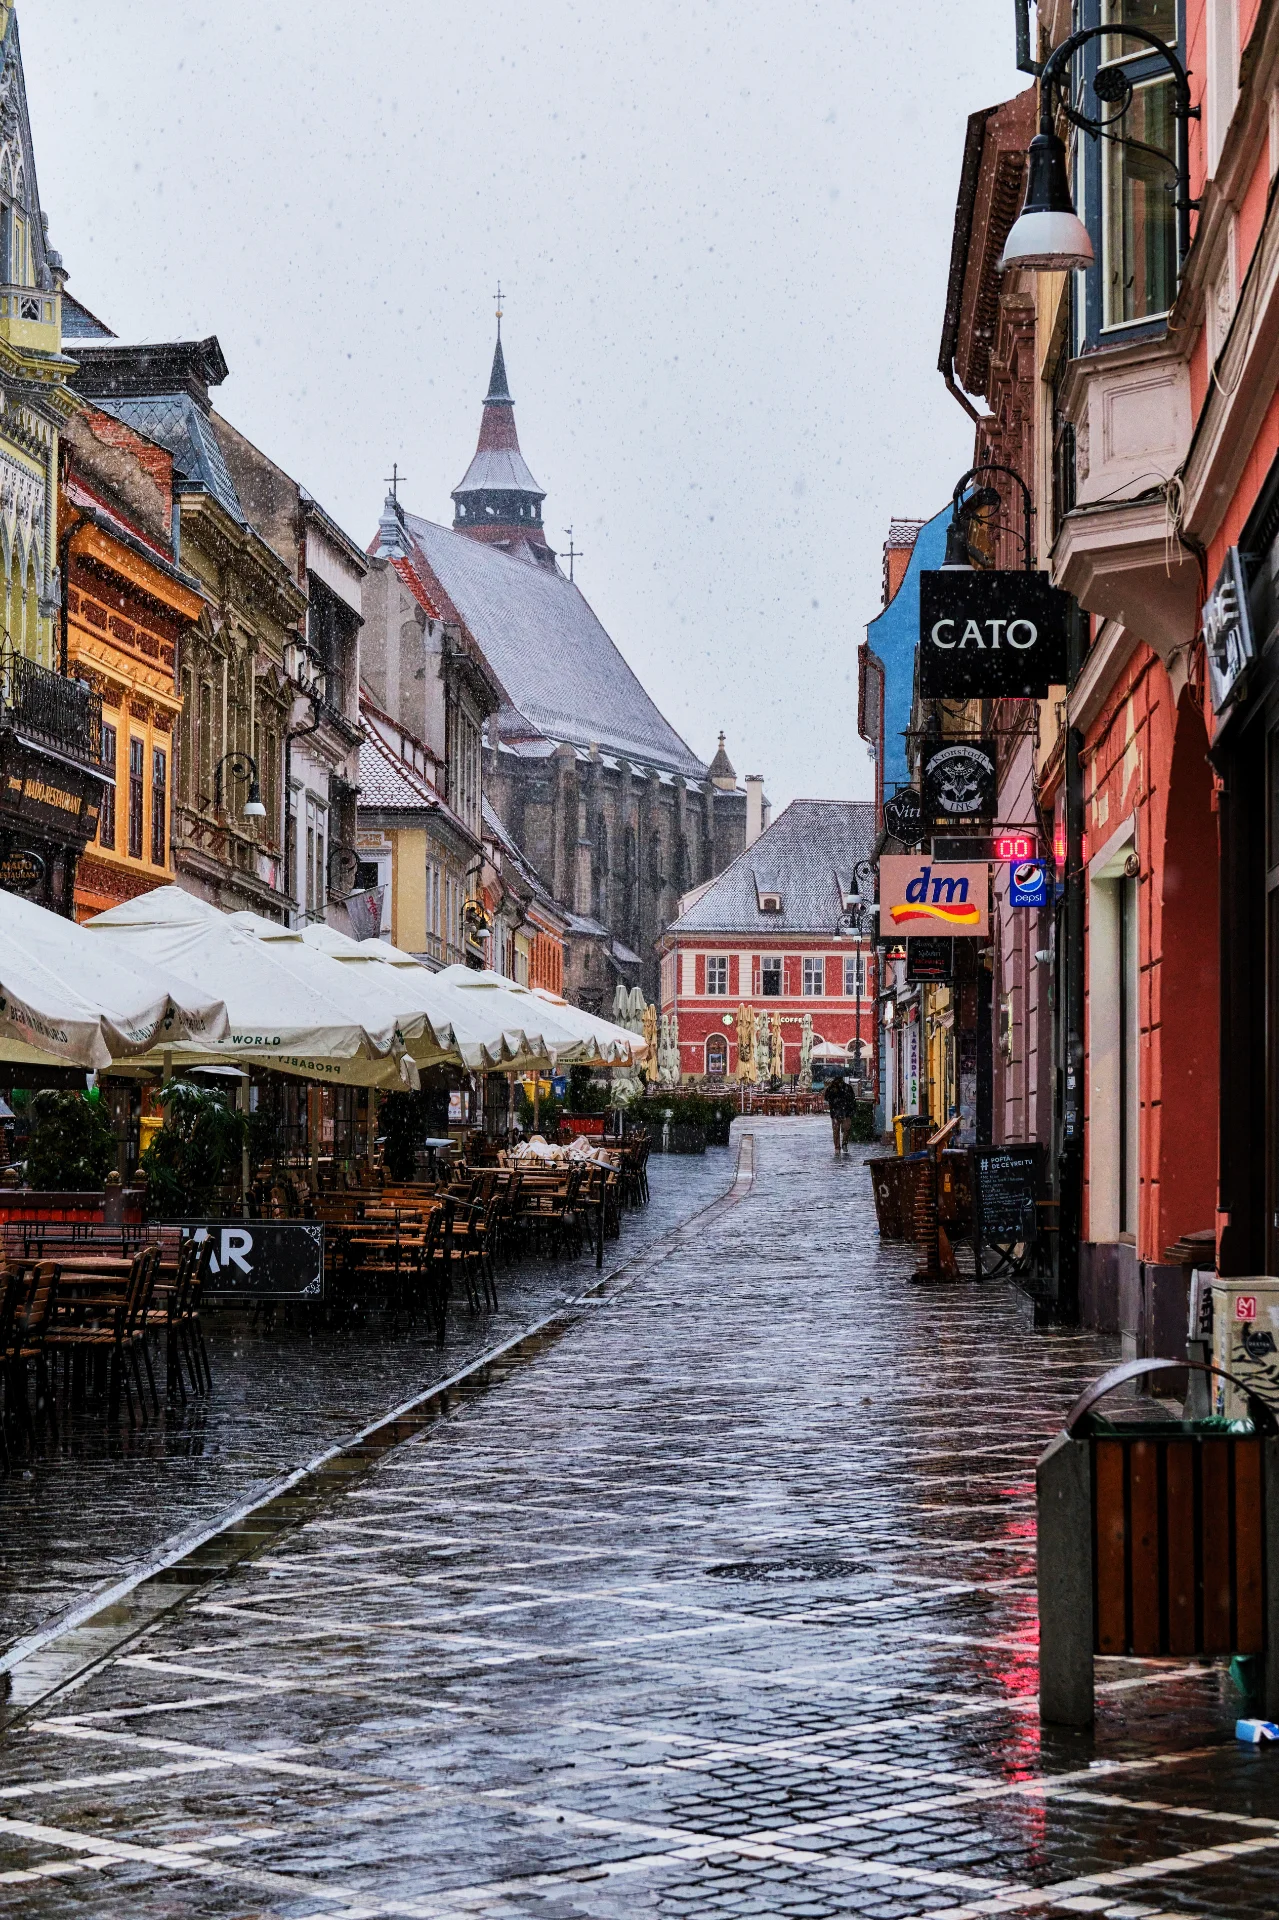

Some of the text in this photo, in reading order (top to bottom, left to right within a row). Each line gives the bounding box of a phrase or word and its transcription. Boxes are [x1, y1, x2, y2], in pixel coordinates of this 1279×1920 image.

[931, 619, 1038, 650] CATO
[950, 802, 973, 810] INK
[2, 861, 32, 870] MADO
[905, 866, 969, 903] dm
[1015, 893, 1042, 903] pepsi
[232, 1035, 281, 1046] WORLD
